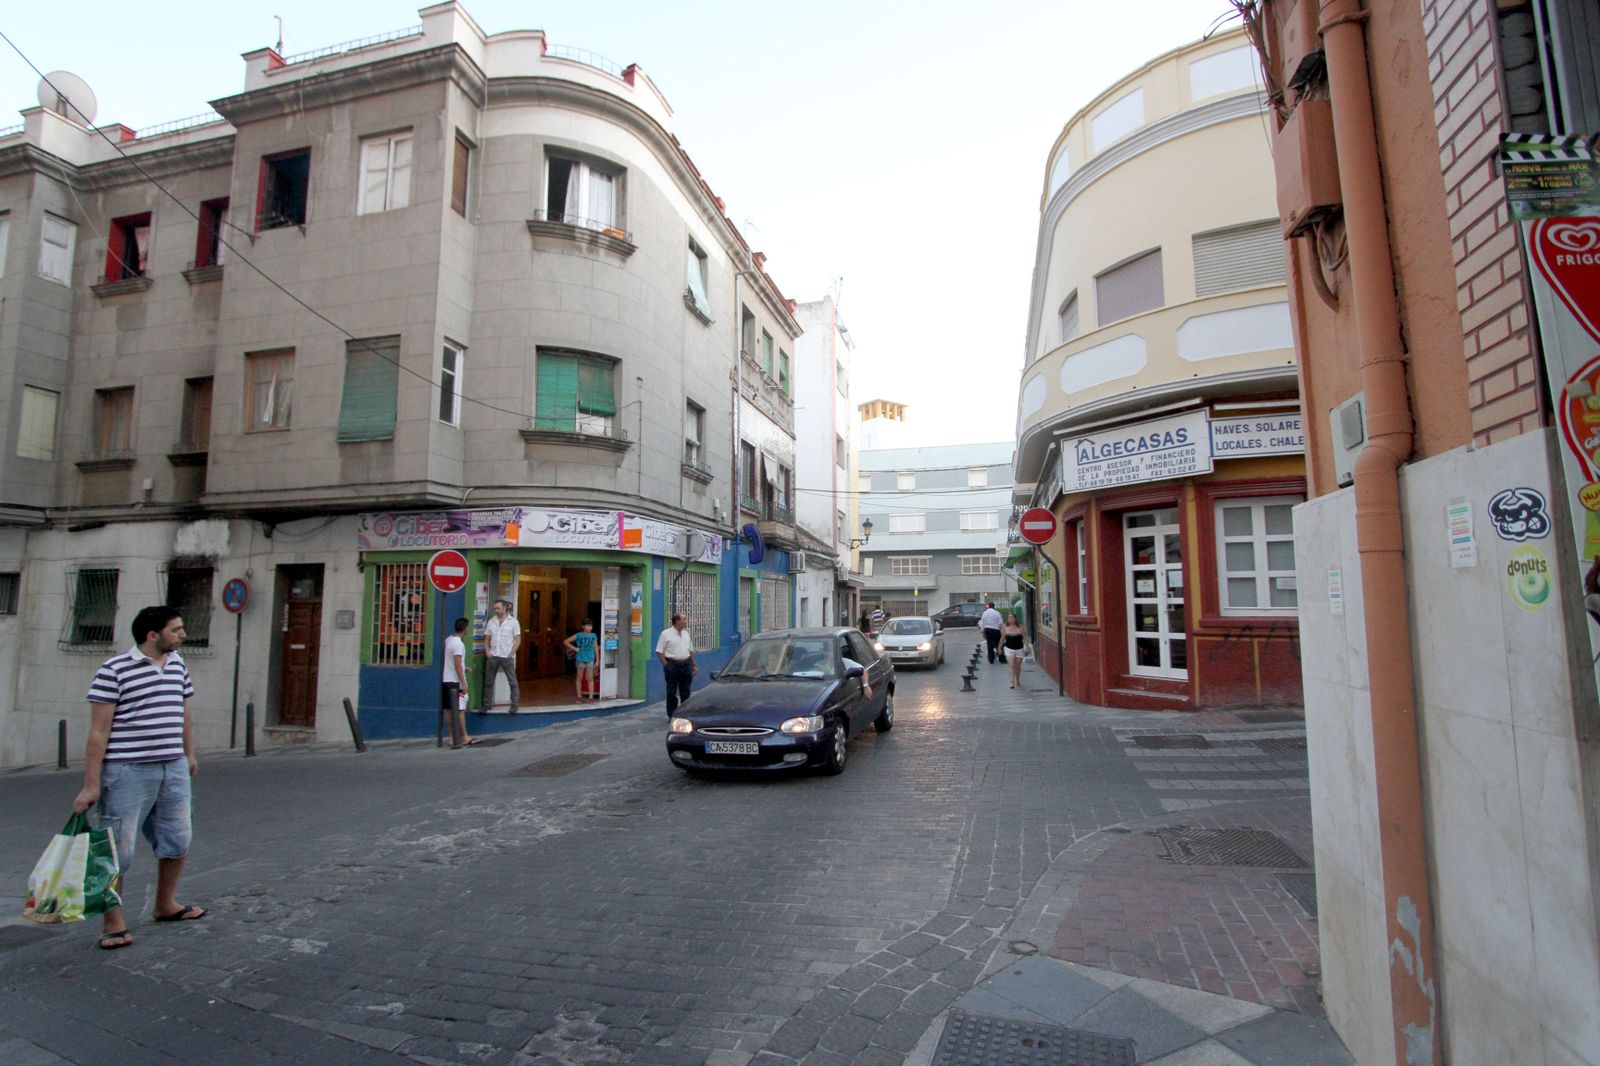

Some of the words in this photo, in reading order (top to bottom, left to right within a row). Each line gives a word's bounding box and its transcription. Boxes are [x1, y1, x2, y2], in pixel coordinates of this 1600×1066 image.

[1079, 427, 1188, 462] ALGECASAS
[1077, 464, 1102, 475] CENTRO
[1106, 459, 1132, 469] ASESOR
[1150, 448, 1196, 462] FINANCIERO
[1077, 474, 1086, 482] DE
[1091, 472, 1099, 480] LA
[1104, 465, 1140, 477] PROPIEDAD
[1145, 456, 1196, 470] INMOBILIARIA
[396, 515, 449, 533] Ciber
[401, 534, 469, 547] LOCUTORIO
[1507, 558, 1548, 576] donuts
